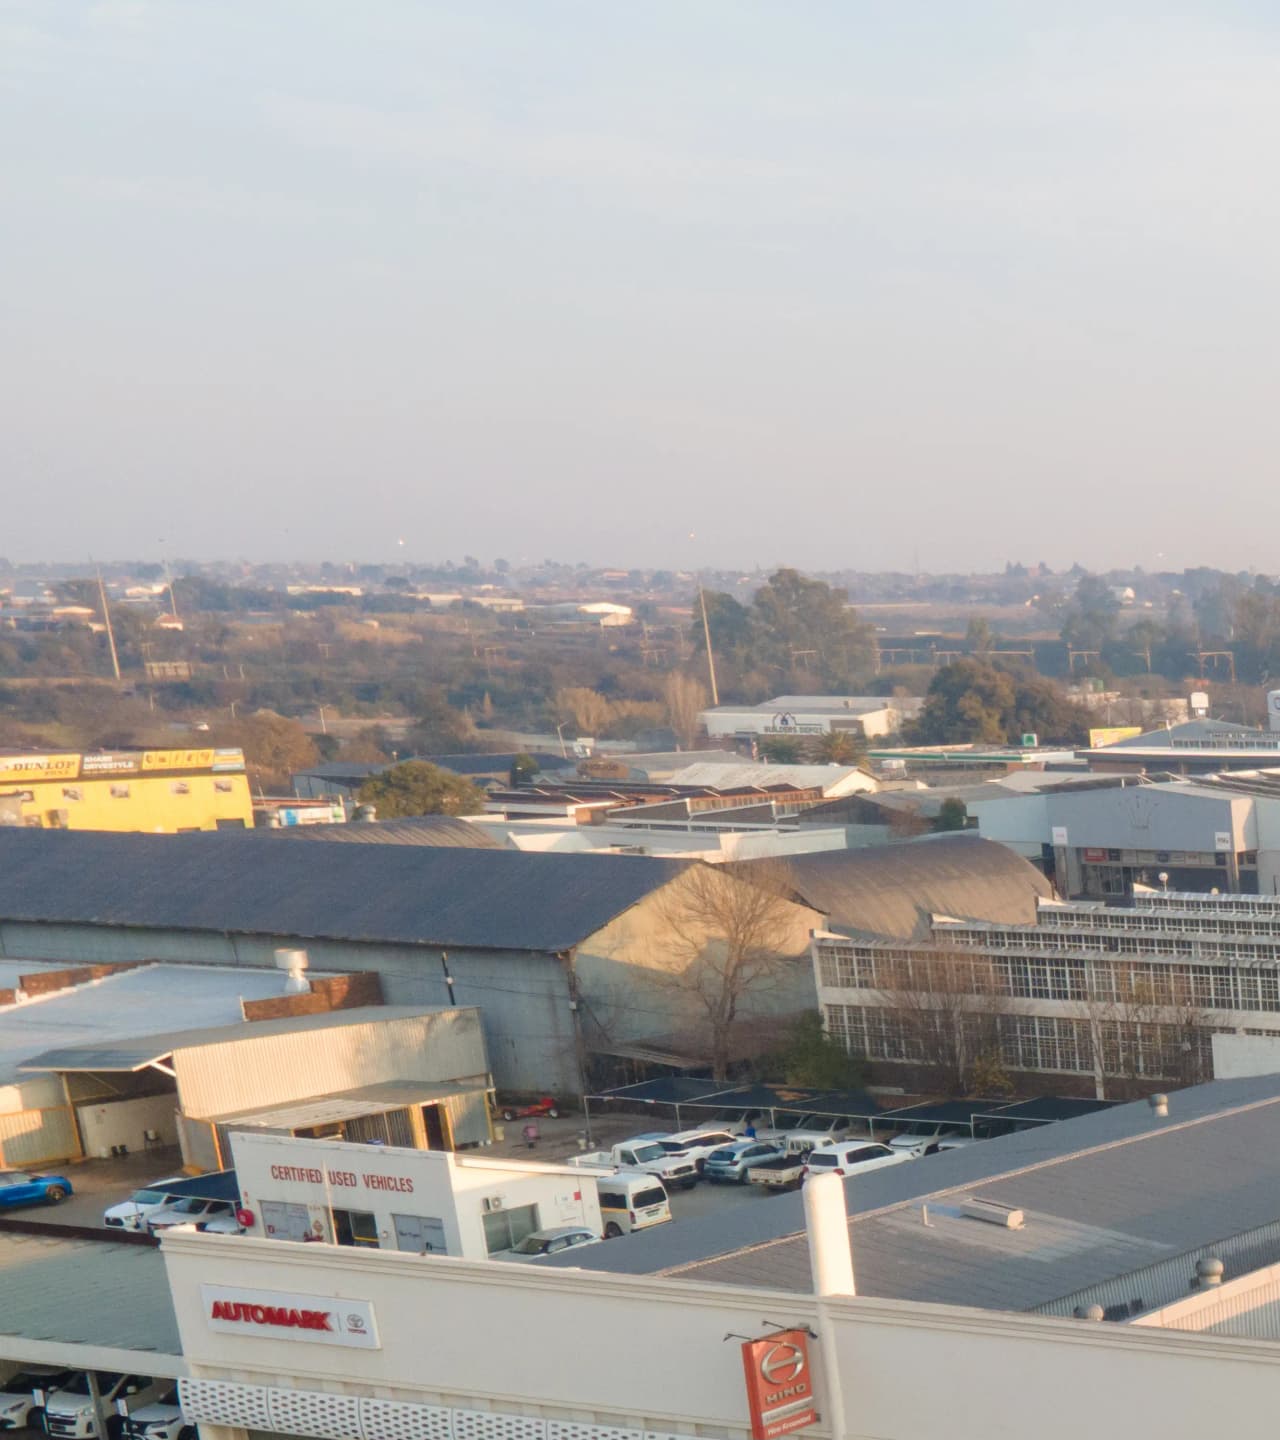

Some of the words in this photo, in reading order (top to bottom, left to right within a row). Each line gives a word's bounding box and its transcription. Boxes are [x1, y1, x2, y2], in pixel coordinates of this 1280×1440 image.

[13, 760, 76, 772] DUNLOP
[271, 1164, 323, 1185] CERTIFIED
[328, 1170, 357, 1188] USED
[363, 1173, 414, 1194] VEHICLES
[211, 1301, 333, 1332] AUTOMARK
[765, 1383, 806, 1406] HINO
